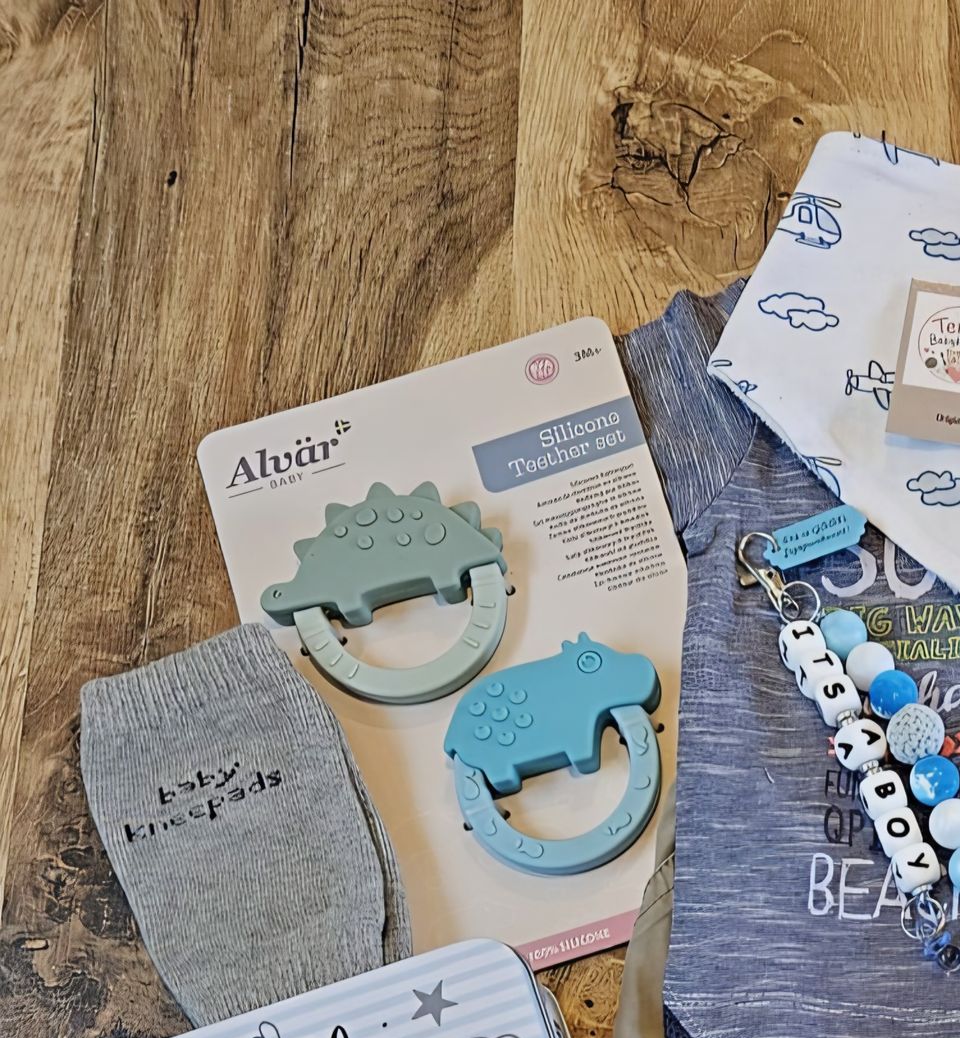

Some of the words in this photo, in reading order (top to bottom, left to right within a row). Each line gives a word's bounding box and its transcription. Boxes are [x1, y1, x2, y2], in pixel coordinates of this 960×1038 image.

[226, 436, 339, 489] Alvär
[508, 440, 591, 478] Teether
[875, 782, 930, 870] BOY
